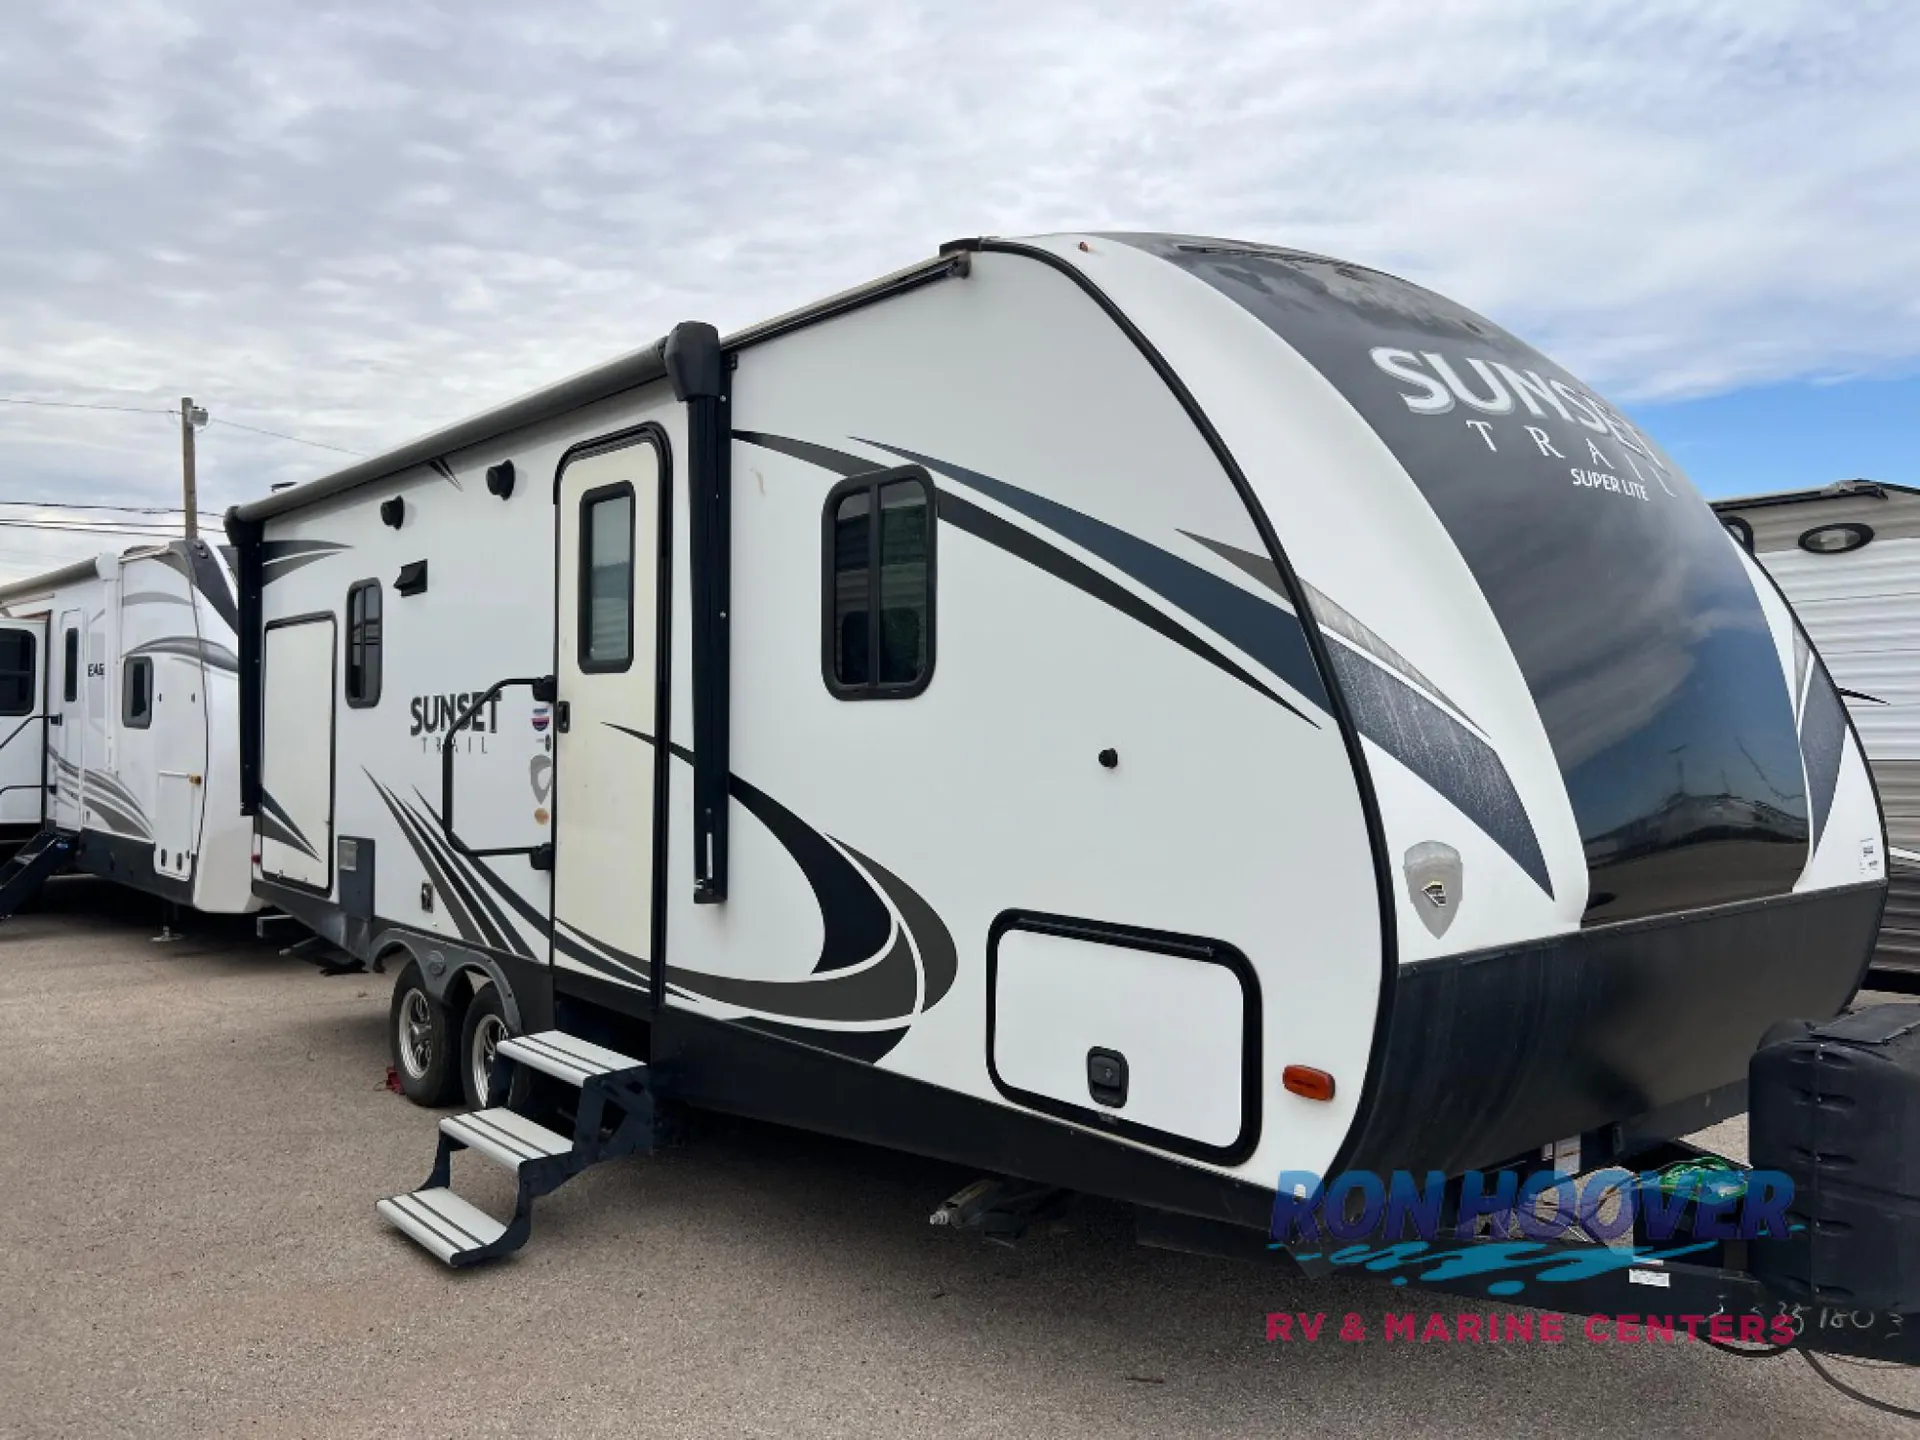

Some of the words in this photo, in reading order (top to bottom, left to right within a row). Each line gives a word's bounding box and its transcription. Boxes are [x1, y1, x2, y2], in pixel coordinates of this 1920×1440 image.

[1369, 346, 1668, 474] SUNSET
[1466, 419, 1678, 498] TRAIL
[1570, 467, 1621, 494] SUPER
[1621, 479, 1650, 501] LITE
[87, 662, 105, 678] EAG
[410, 691, 503, 736] SUNSET
